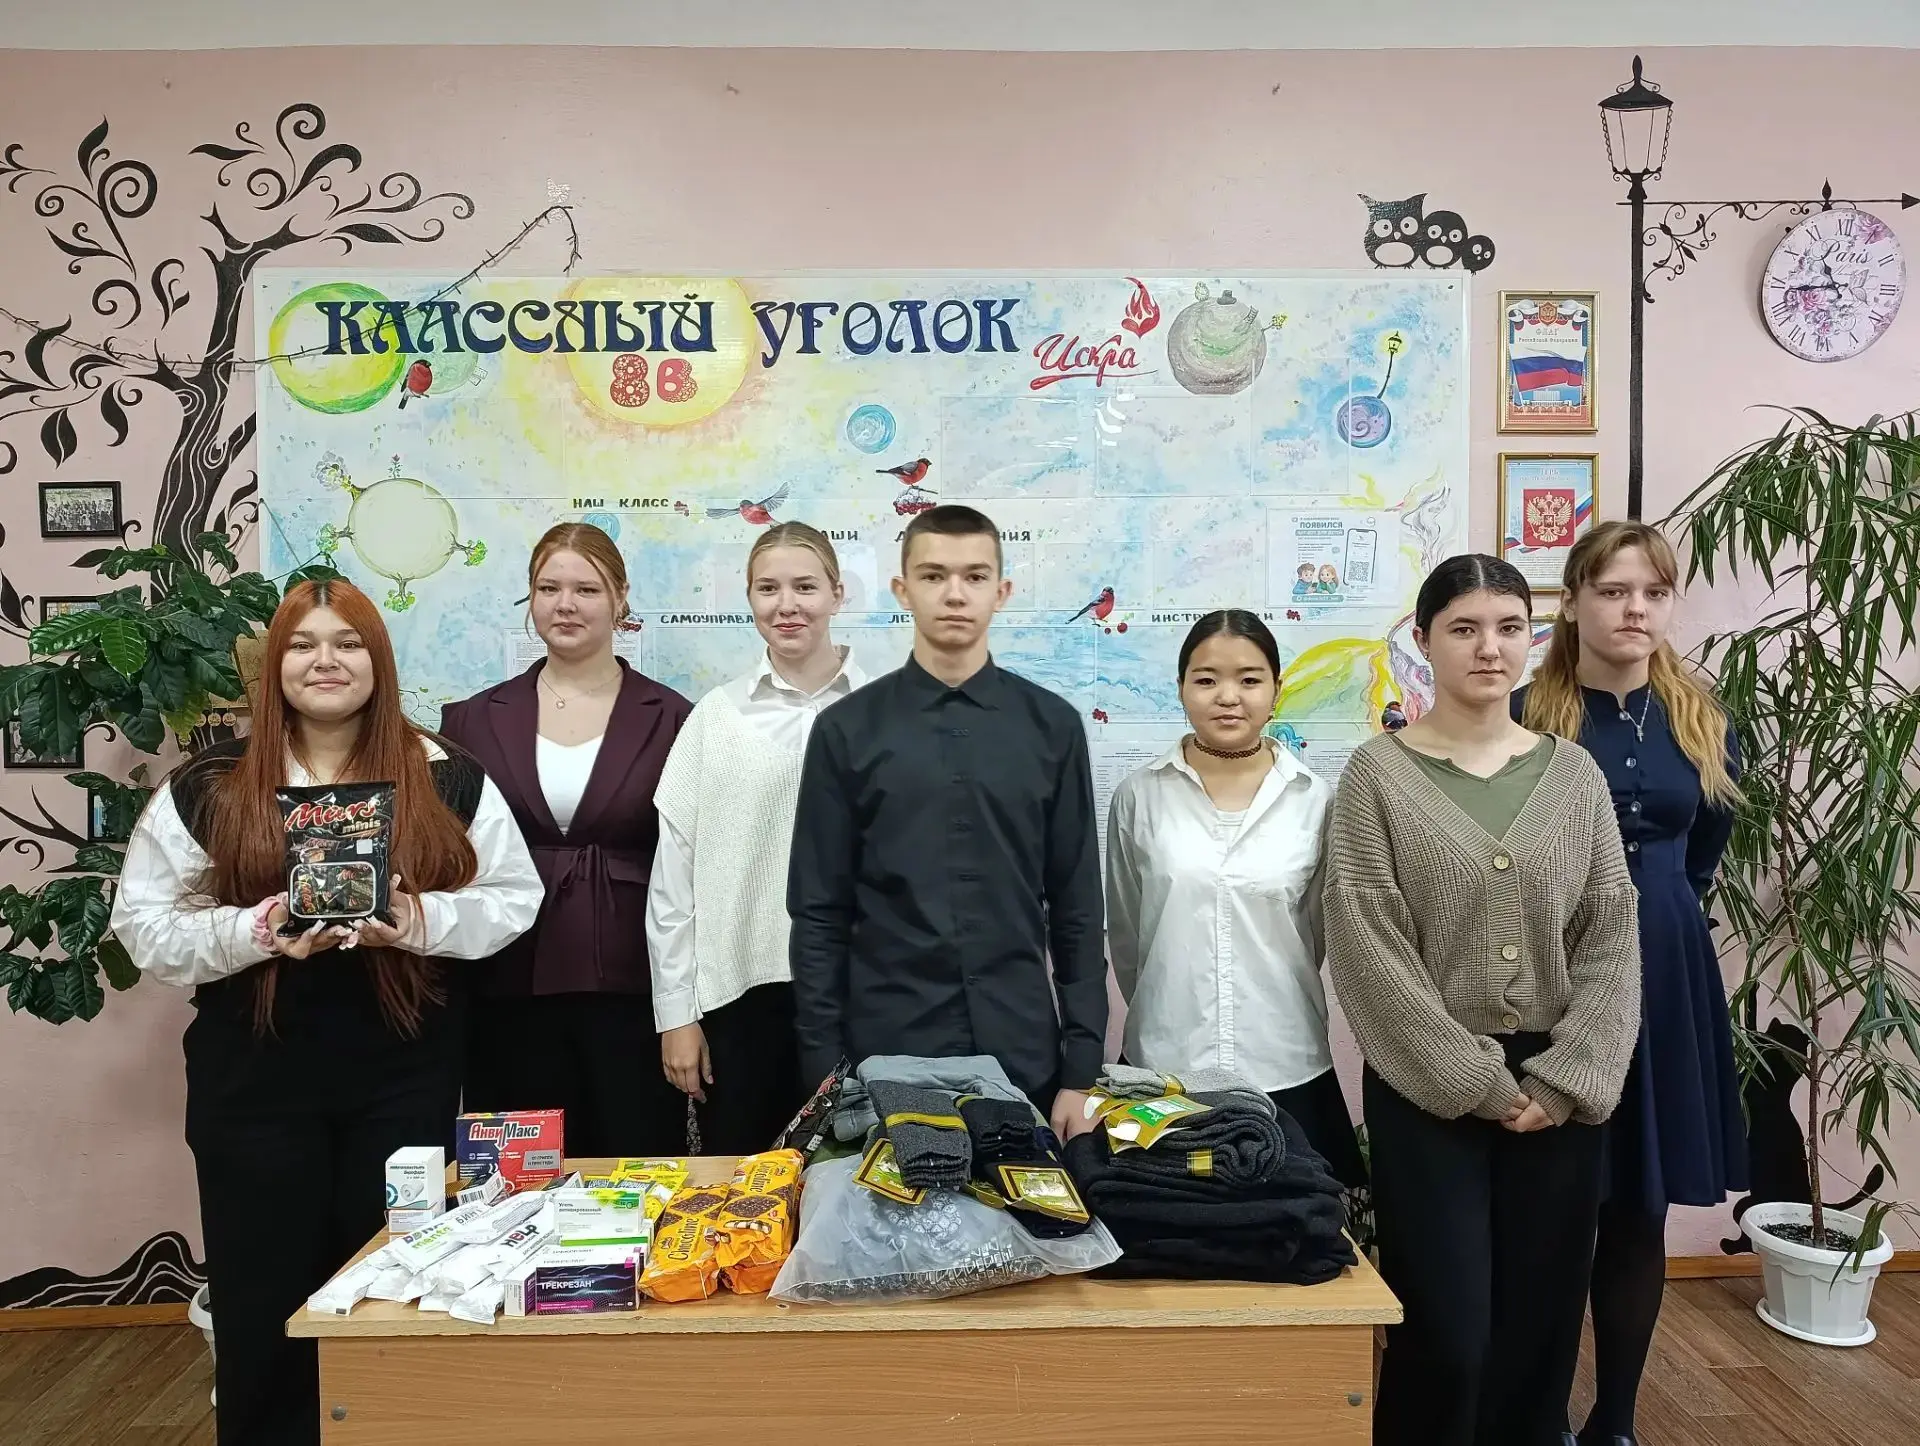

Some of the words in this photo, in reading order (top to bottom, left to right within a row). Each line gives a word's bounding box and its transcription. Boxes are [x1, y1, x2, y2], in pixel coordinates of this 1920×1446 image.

[1808, 238, 1873, 264] Paris
[315, 293, 718, 355] КЛАССНЫЙ
[750, 298, 1020, 369] УГОЛОК
[1031, 332, 1144, 388] Искра
[573, 498, 605, 509] НАШ
[619, 498, 669, 508] КЛАСС
[1299, 521, 1343, 529] ПОЯВИЛСЯ
[660, 614, 754, 624] САМОУПРАВЛ
[284, 800, 381, 832] Mars
[342, 818, 381, 834] minis
